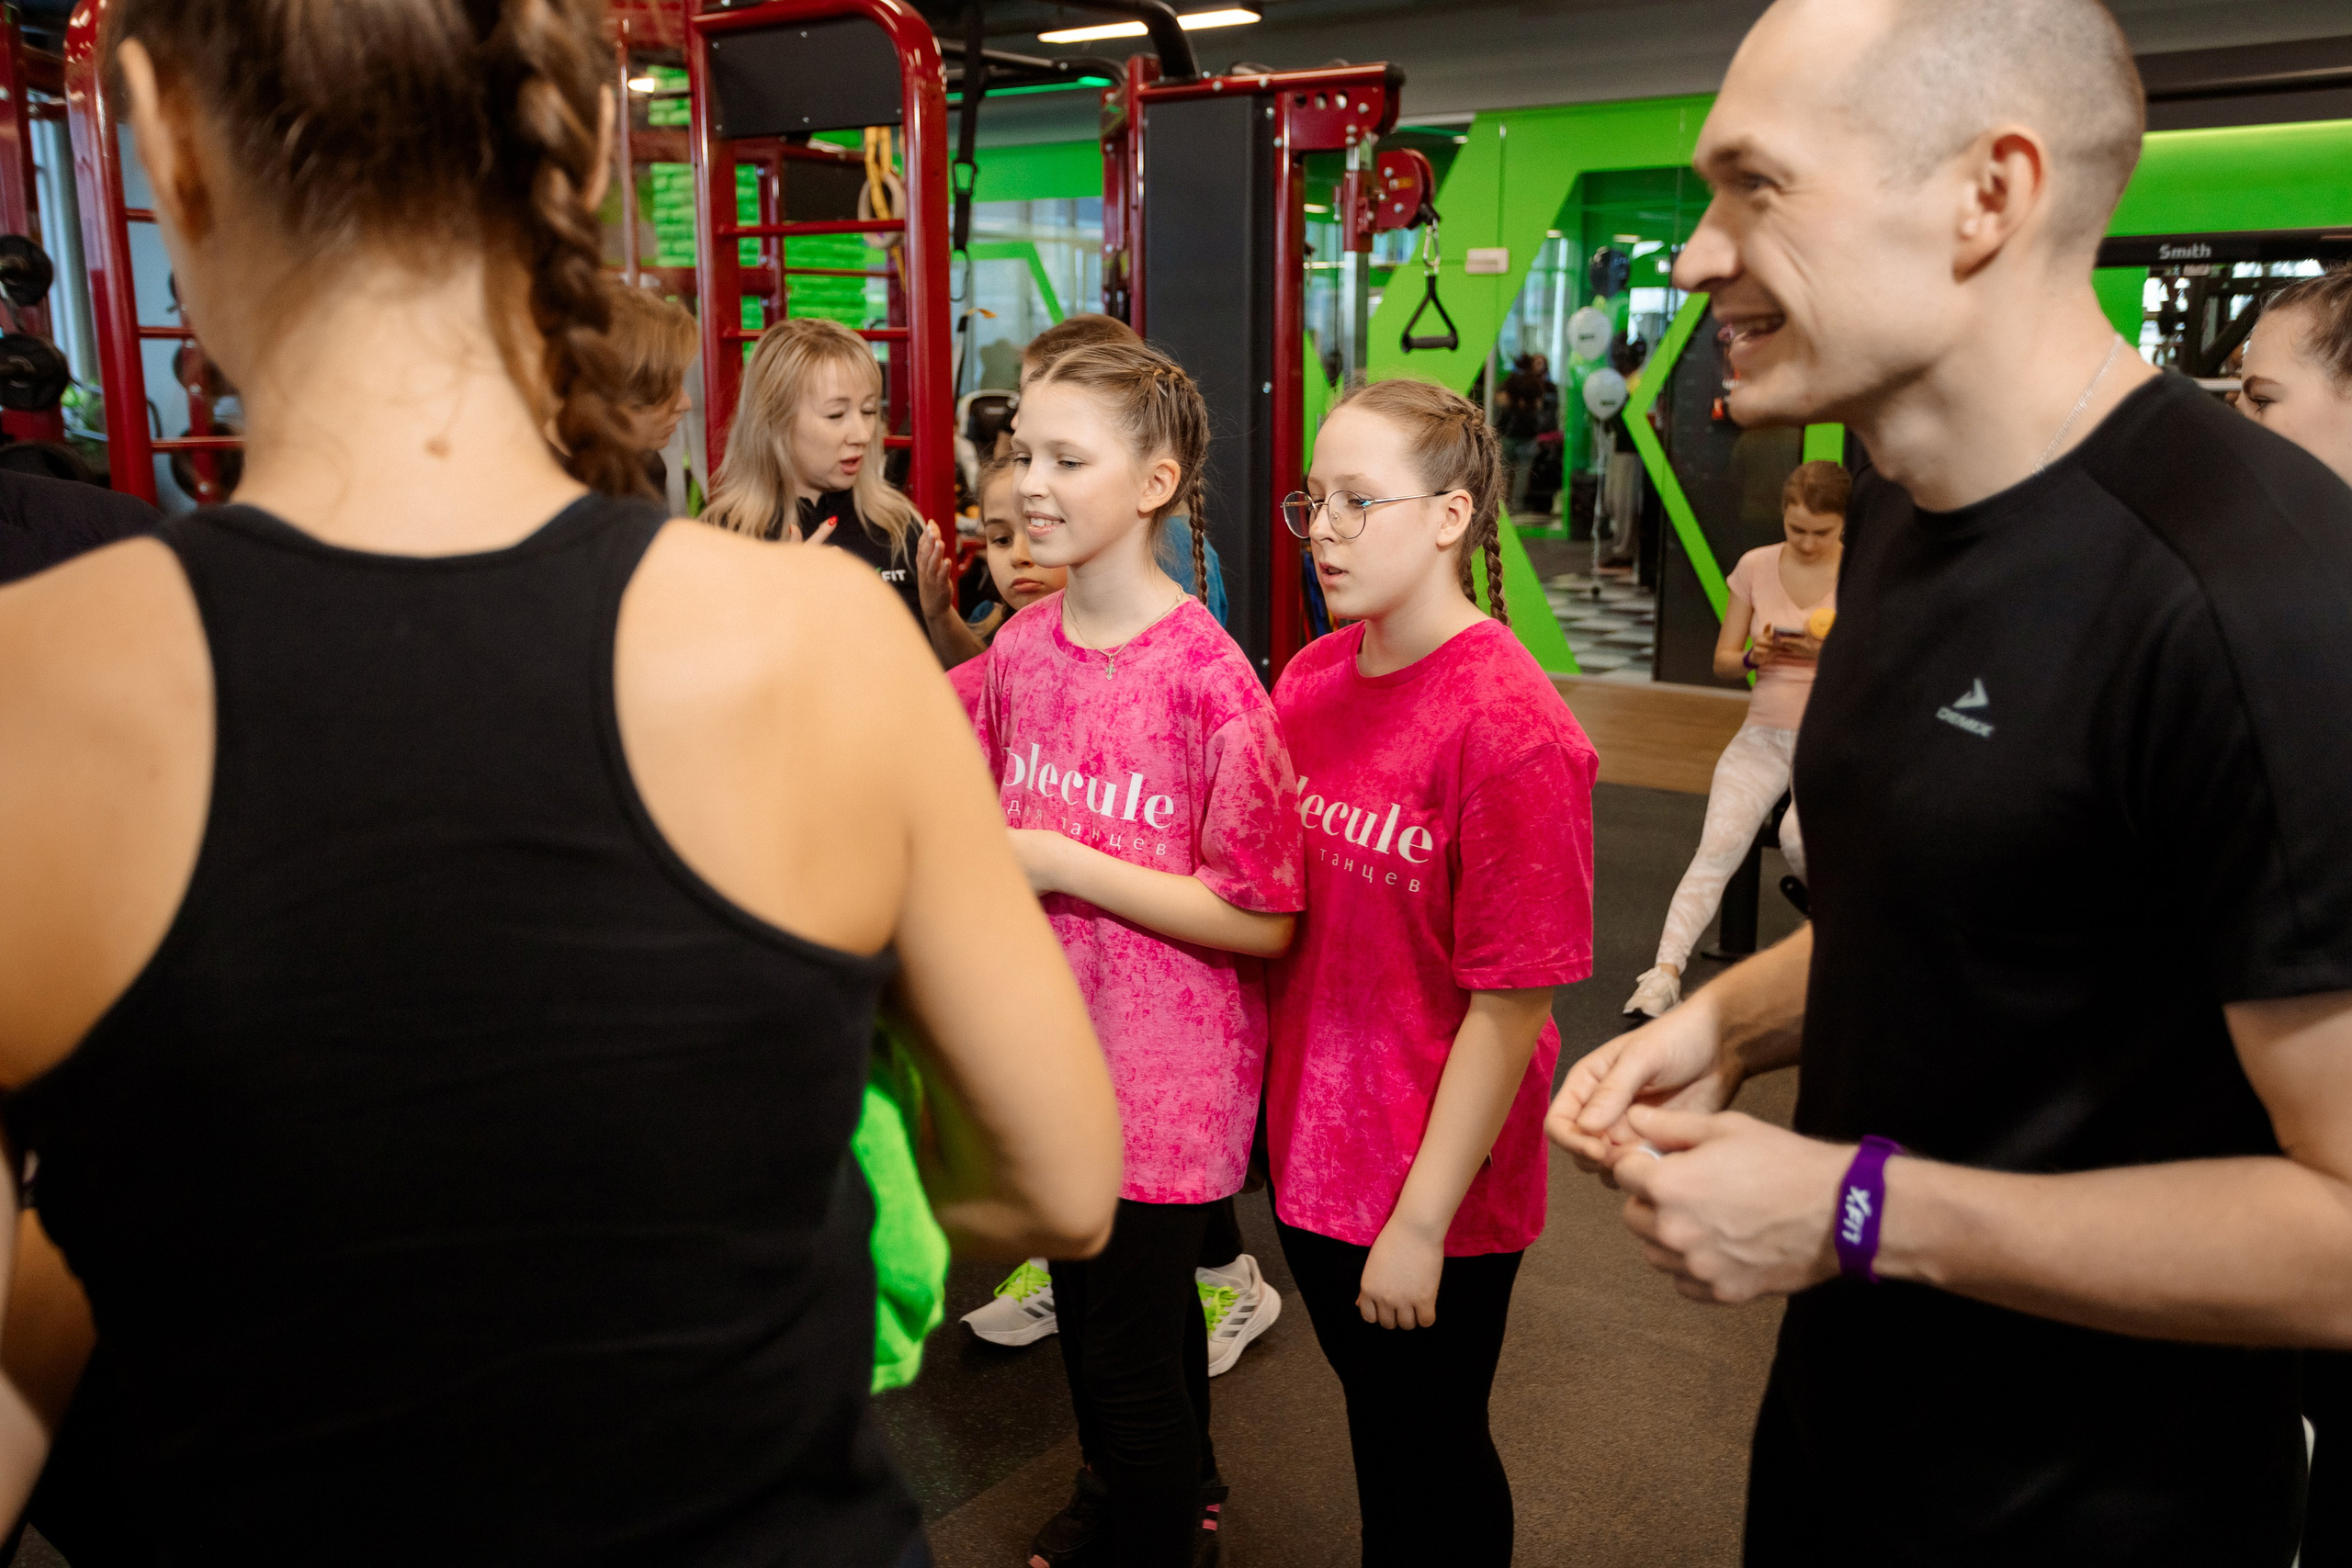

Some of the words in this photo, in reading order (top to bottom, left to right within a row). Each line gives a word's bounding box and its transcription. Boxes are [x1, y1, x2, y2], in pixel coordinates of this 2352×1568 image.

[2159, 243, 2211, 259] Smith
[876, 568, 906, 581] FIT
[1003, 742, 1174, 829] olecule
[1060, 817, 1167, 856] танцев
[1320, 848, 1420, 893] танцев
